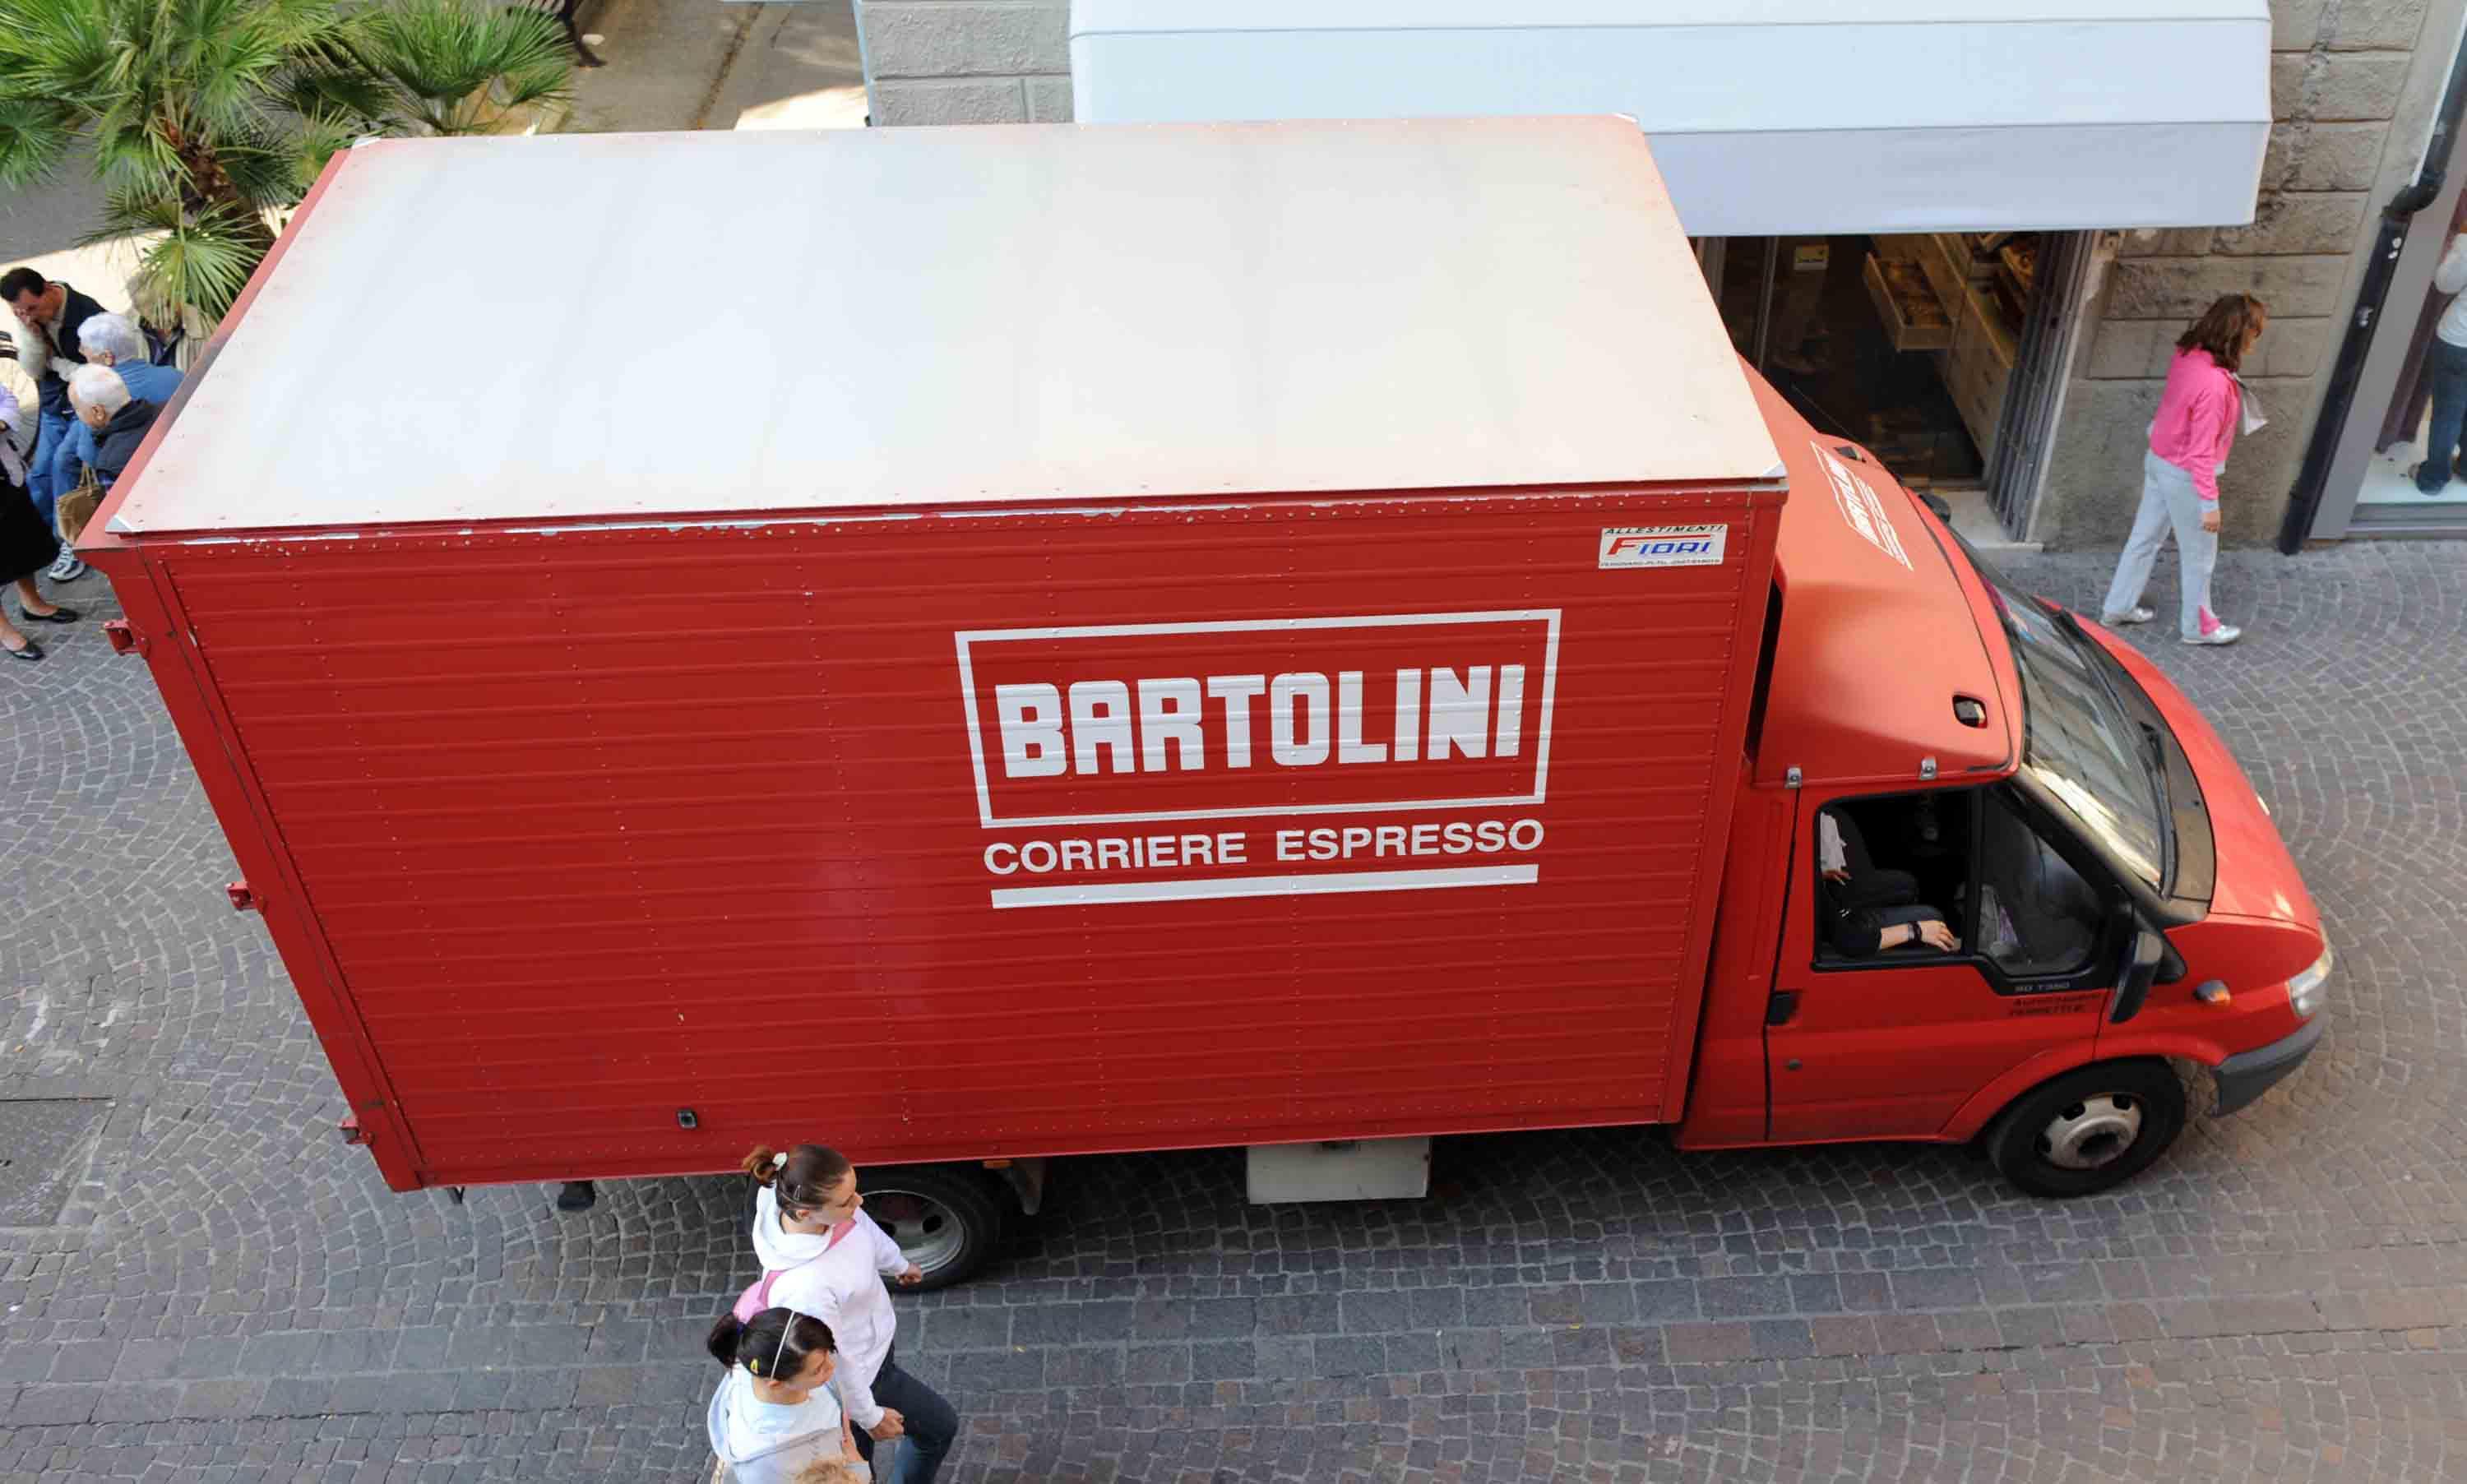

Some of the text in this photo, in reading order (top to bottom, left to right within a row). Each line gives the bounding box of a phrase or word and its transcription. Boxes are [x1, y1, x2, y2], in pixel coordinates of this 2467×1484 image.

[1604, 525, 1724, 534] ALLESTIMENTI
[1606, 534, 1711, 556] FIORI
[994, 663, 1526, 779] BARTOLINI
[984, 818, 1545, 876] CORRIERE ESPRESSO
